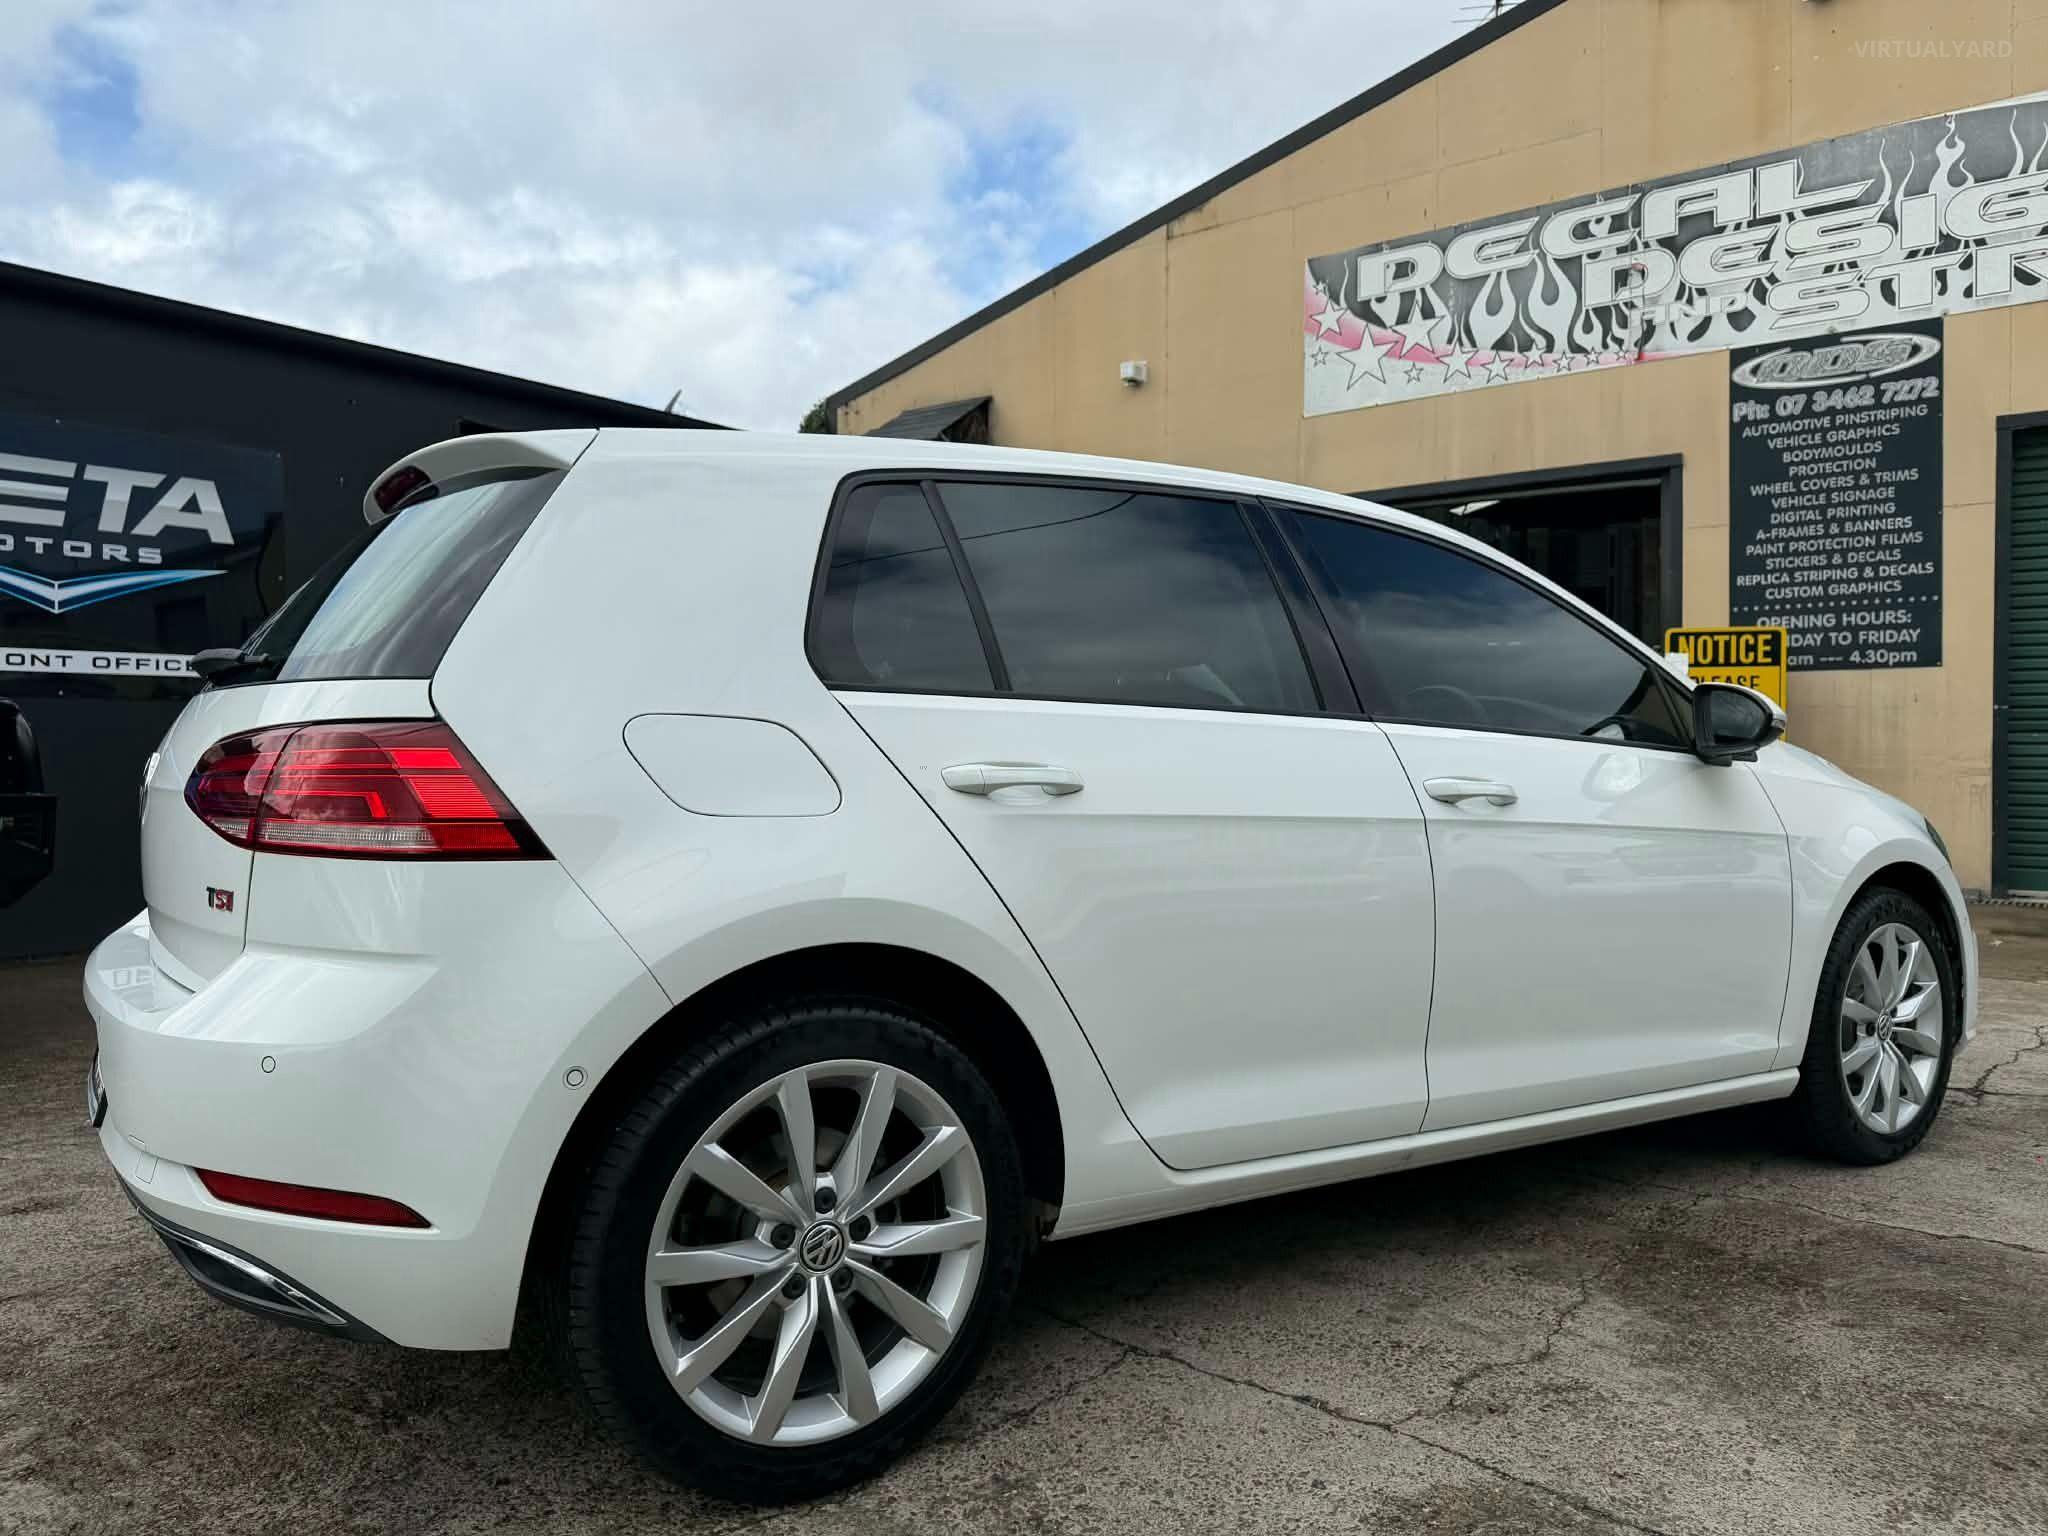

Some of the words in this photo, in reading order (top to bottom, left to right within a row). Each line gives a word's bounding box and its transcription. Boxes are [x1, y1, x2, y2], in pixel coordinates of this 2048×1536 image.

[1356, 158, 1876, 302] DECAL
[1582, 168, 2048, 309] DESIG
[1769, 235, 2048, 330] STR
[1776, 394, 1808, 417] 07
[1812, 384, 1875, 412] 3462
[1880, 376, 1940, 404] 7272
[1742, 416, 1831, 438] AUTOMOTIVE
[1835, 404, 1929, 426] PINSTRIPING
[1767, 432, 1822, 450] VEHICLE
[1826, 423, 1900, 443] GRAPHICS
[1782, 441, 1883, 463] BODYMOULDS
[1788, 457, 1876, 477] PROTECTION
[1750, 480, 1796, 496] WHEEL
[1800, 475, 1855, 492] COVERS
[1859, 473, 1870, 486] &
[1875, 468, 1919, 484] TRIMS
[0, 452, 235, 545] ETA
[1771, 491, 1826, 509] VEHICLE
[1831, 486, 1896, 504] SIGNAGE
[1770, 509, 1823, 525] DIGITAL
[1827, 502, 1896, 519] PRINTING
[1756, 524, 1825, 541] A-FRAMES
[1829, 521, 1840, 535] &
[1844, 516, 1913, 534] BANNERS
[0, 533, 163, 565] OTORS
[1745, 542, 1785, 557] PAINT
[1789, 536, 1876, 554] PROTECTION
[1881, 531, 1924, 545] FILMS
[1765, 553, 1828, 570] STICKERS
[1831, 552, 1842, 565] &
[1847, 549, 1902, 563] DECALS
[1736, 571, 1790, 587] REPLICA
[1794, 567, 1859, 584] STRIPING
[1863, 565, 1874, 578] &
[1879, 562, 1934, 578] DECALS
[1765, 584, 1824, 600] CUSTOM
[1828, 580, 1902, 597] GRAPHICS
[1757, 613, 1837, 629] OPENING
[1842, 610, 1913, 626] HOURS:
[1678, 633, 1772, 665] NOTICE
[1787, 631, 1825, 648] DAY
[1828, 631, 1852, 646] TO
[1858, 628, 1921, 645] FRIDAY
[5, 653, 73, 667] ONT
[1787, 655, 1814, 666] am
[1849, 649, 1918, 667] 4.30pm
[206, 886, 234, 912] TSI
